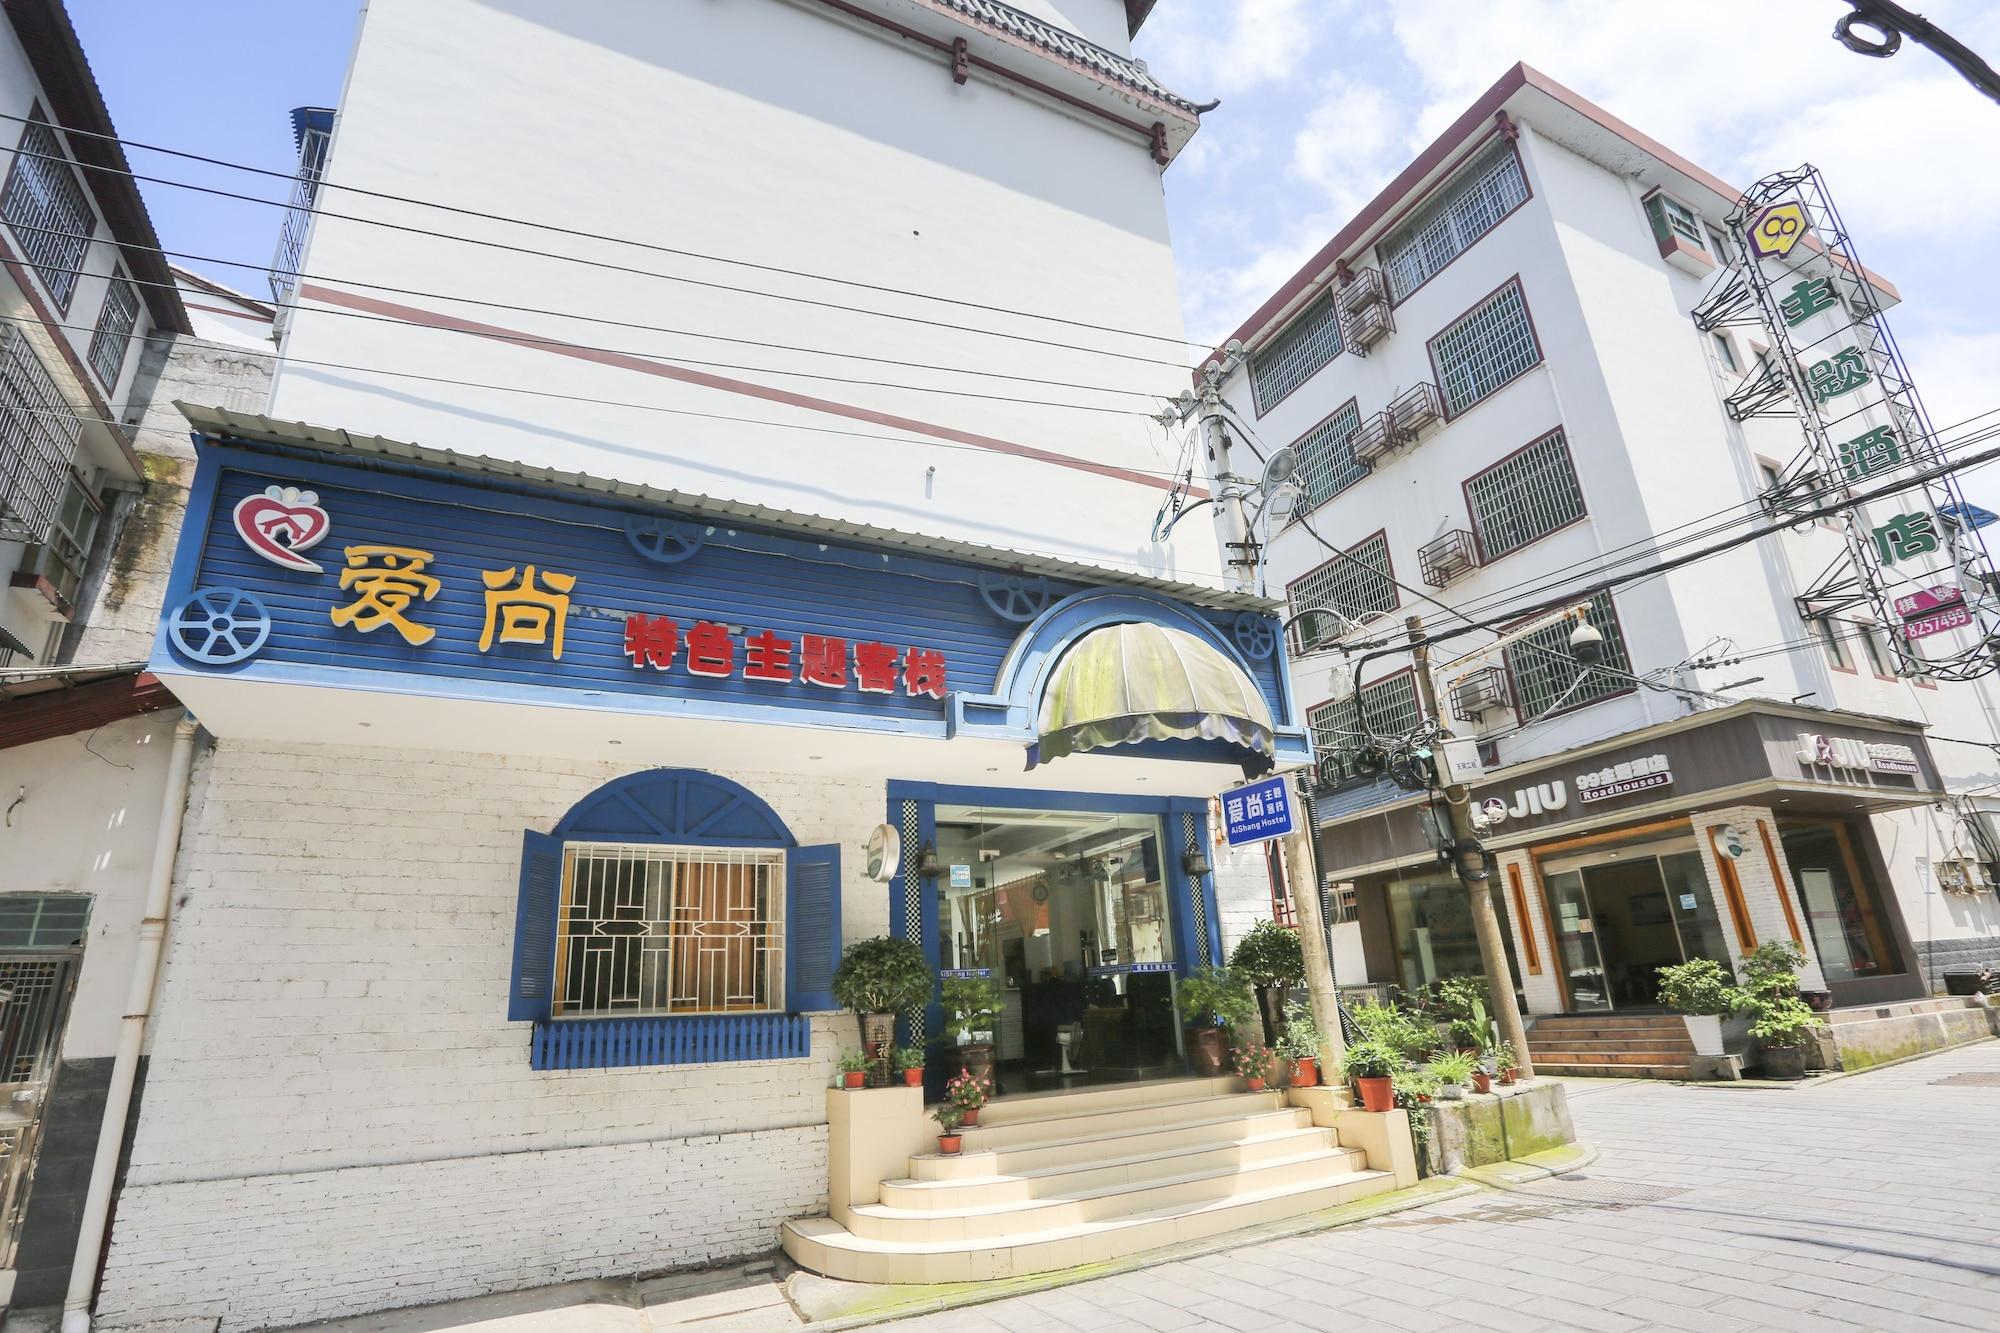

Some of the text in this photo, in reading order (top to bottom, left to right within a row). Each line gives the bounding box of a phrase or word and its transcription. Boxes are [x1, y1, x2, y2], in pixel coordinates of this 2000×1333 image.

[1763, 216, 1798, 247] 99
[1779, 277, 1940, 567] 主题酒店
[331, 546, 947, 700] 爱尚 特色主题客栈
[1583, 776, 1663, 800] Roadhouses
[1227, 793, 1264, 824] 爱尚
[1231, 815, 1286, 834] AiShang Hostel
